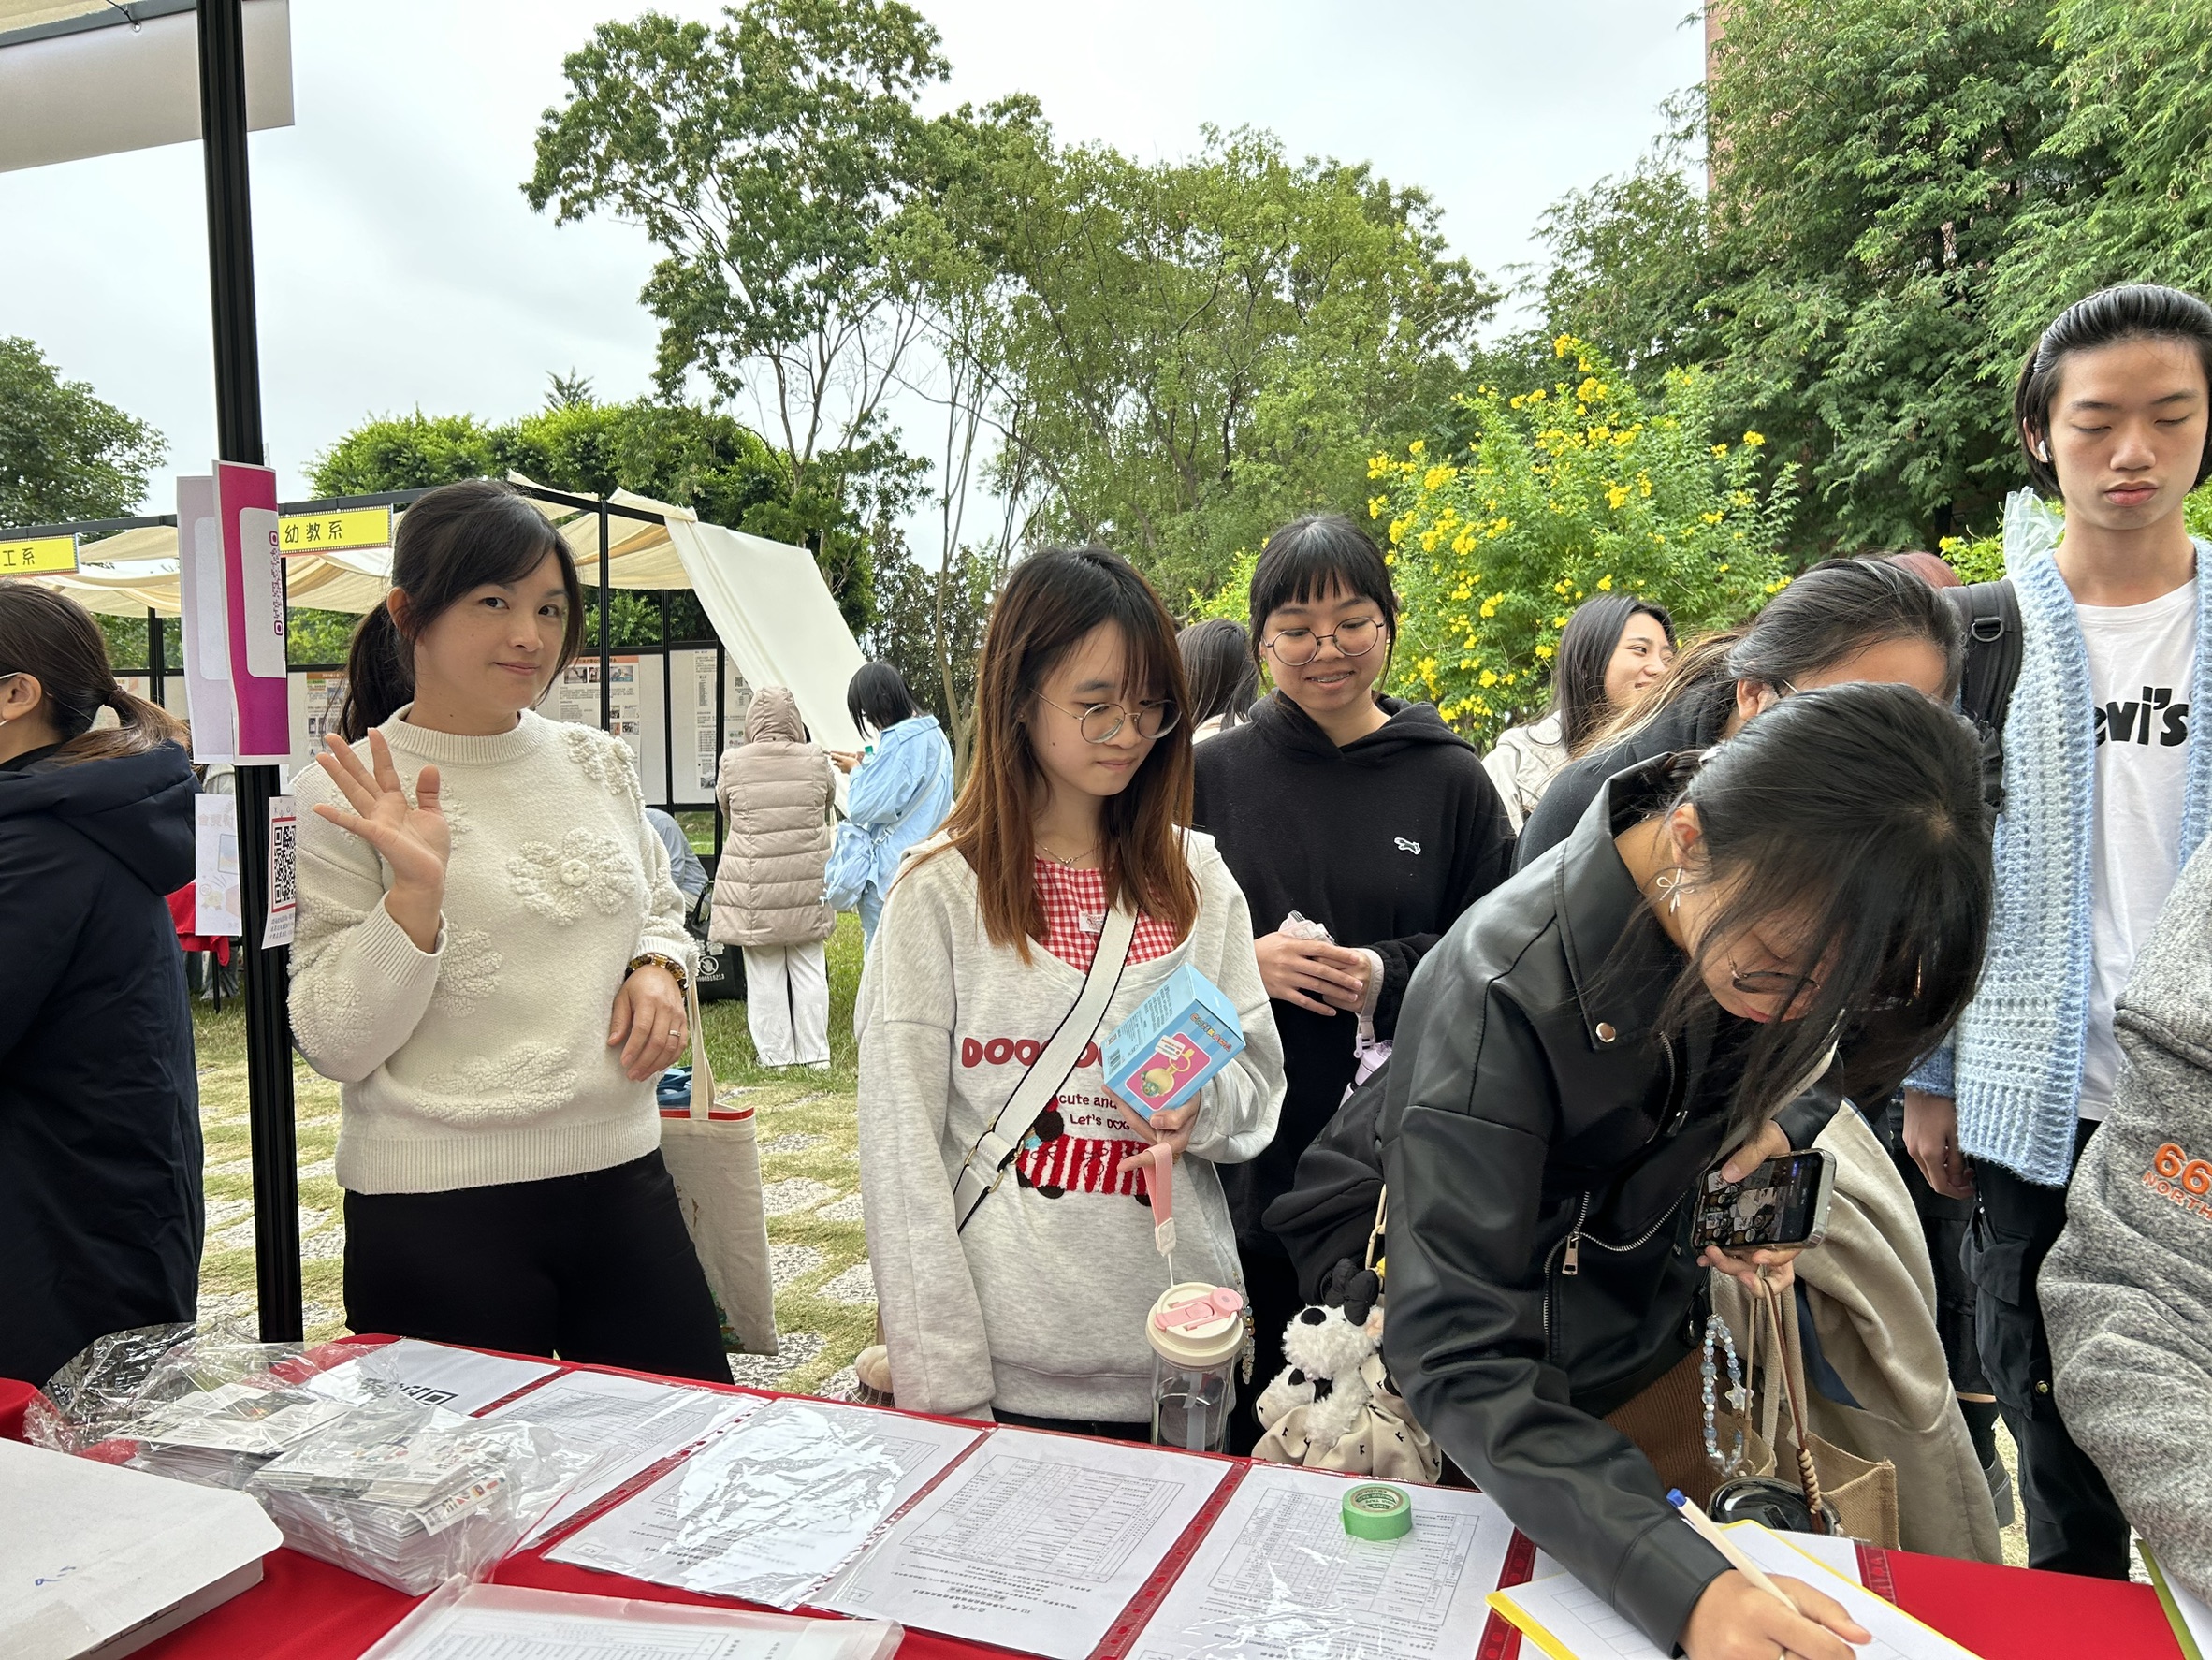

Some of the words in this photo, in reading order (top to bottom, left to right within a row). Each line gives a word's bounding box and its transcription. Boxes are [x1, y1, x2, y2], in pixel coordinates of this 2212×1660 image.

[284, 519, 342, 544] 幼教系
[2, 547, 36, 567] 工系
[1058, 1093, 1090, 1105] cute
[1070, 1114, 1102, 1126] Let's
[2141, 1170, 2212, 1220] NORTH
